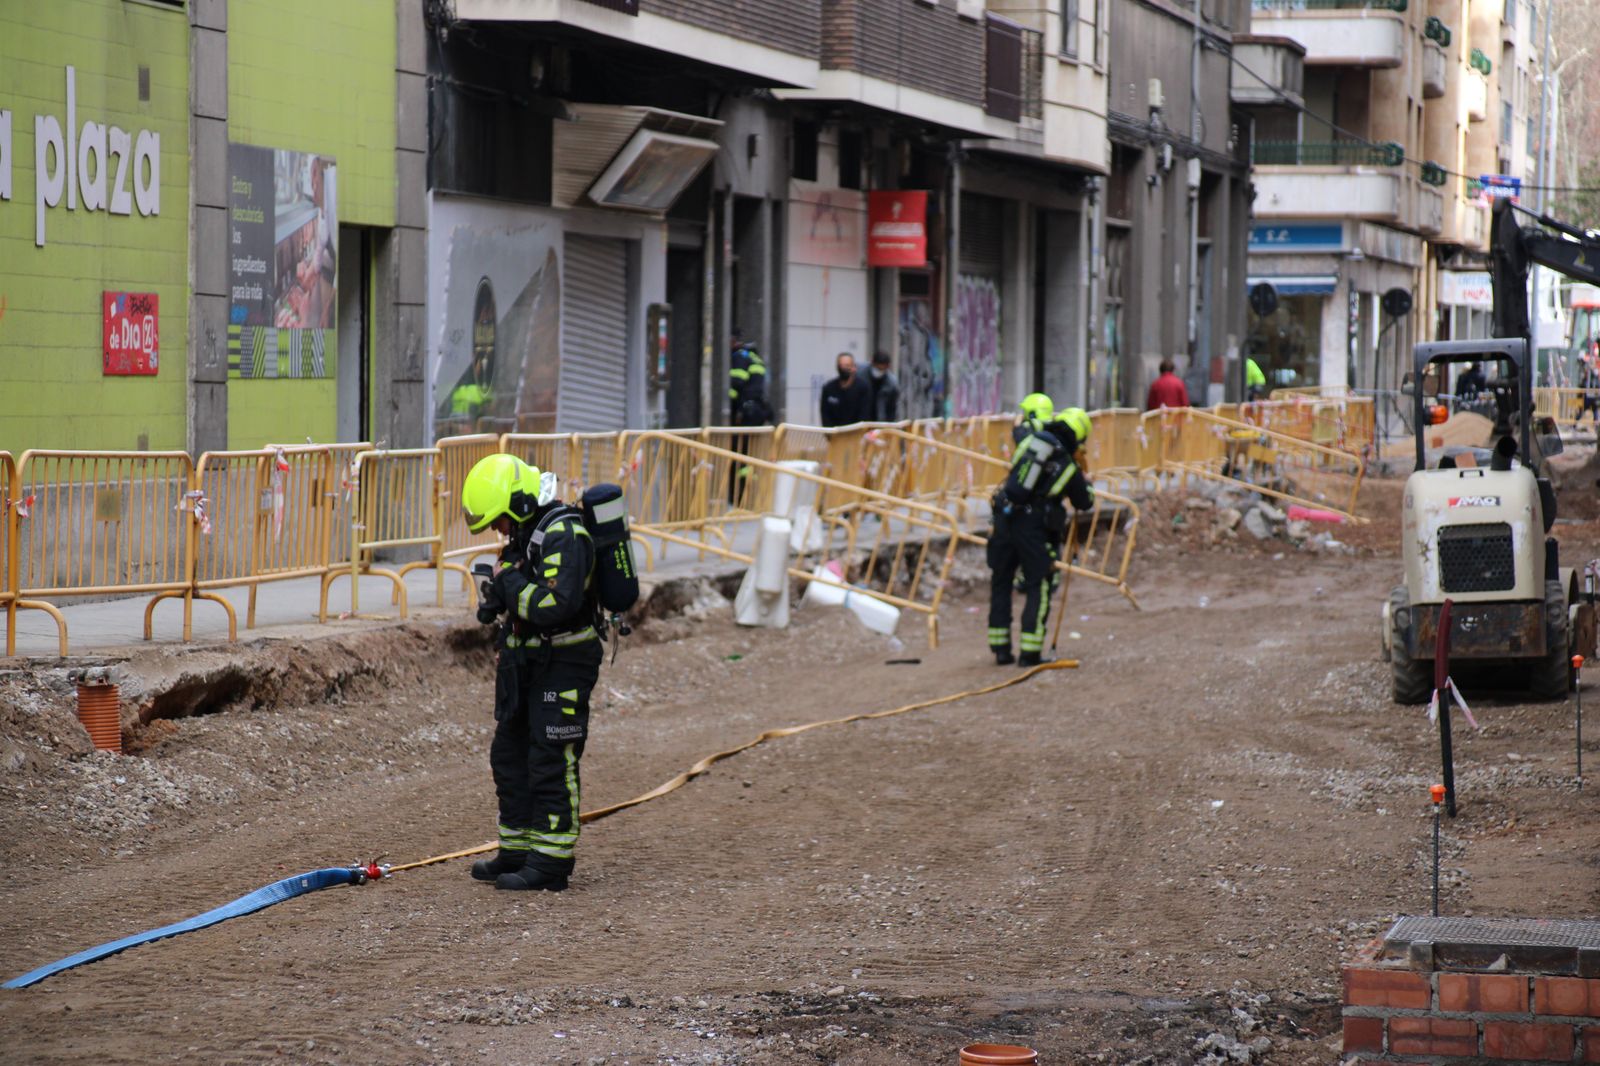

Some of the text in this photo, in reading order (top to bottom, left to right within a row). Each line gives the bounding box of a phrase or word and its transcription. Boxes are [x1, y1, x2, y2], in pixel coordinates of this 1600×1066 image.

[35, 64, 161, 247] plaza
[109, 325, 120, 349] de
[543, 691, 557, 702] 162
[545, 724, 583, 734] BOMBEROS
